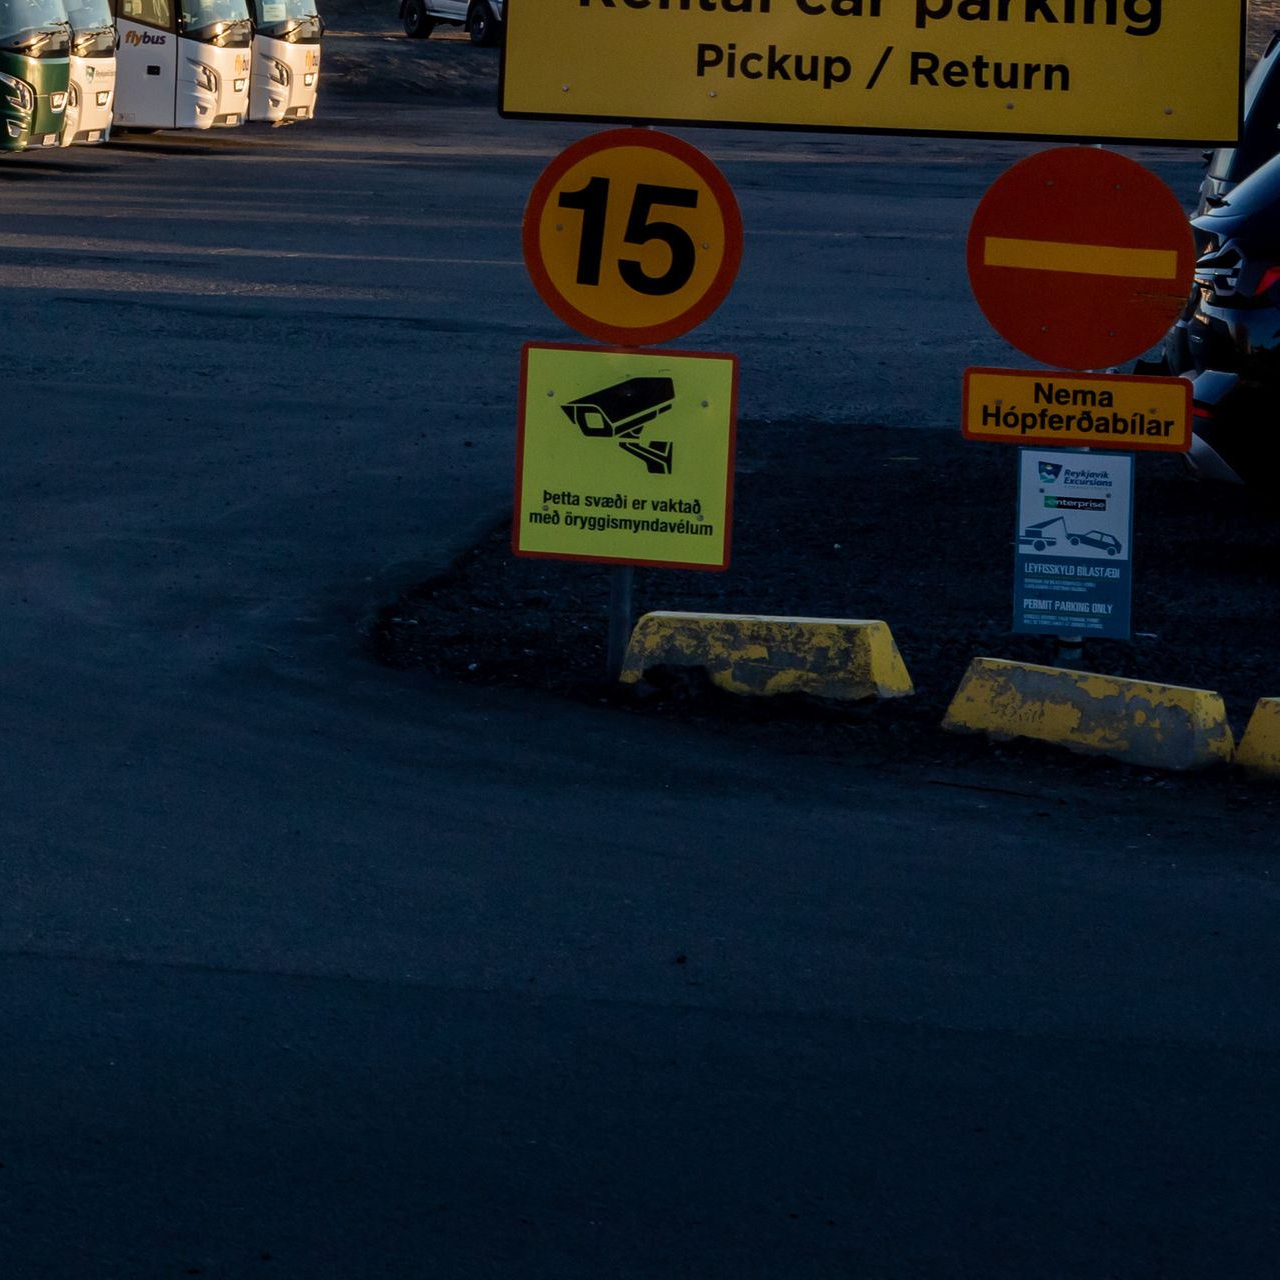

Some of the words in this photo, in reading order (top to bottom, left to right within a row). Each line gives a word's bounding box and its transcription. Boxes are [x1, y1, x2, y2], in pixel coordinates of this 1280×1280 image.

[125, 30, 167, 48] flybus
[696, 43, 852, 90] Pickup
[865, 46, 894, 90] /
[909, 51, 1070, 91] Return
[558, 176, 699, 296] 15
[1034, 382, 1114, 408] Nema
[982, 405, 1175, 437] Hópferðabílar
[1064, 469, 1109, 480] Reykjavik
[1064, 477, 1112, 486] Excursions
[543, 490, 581, 506] Þetta
[584, 494, 628, 510] svæði
[632, 500, 647, 510] er
[651, 498, 702, 515] vaktað
[529, 511, 560, 525] með
[564, 511, 714, 536] öryggismyndavélum
[1025, 562, 1075, 576] LEYFISSKYLD
[1024, 598, 1053, 611] PERMIT
[1055, 600, 1089, 614] PARKING
[1091, 603, 1114, 614] ONLY
